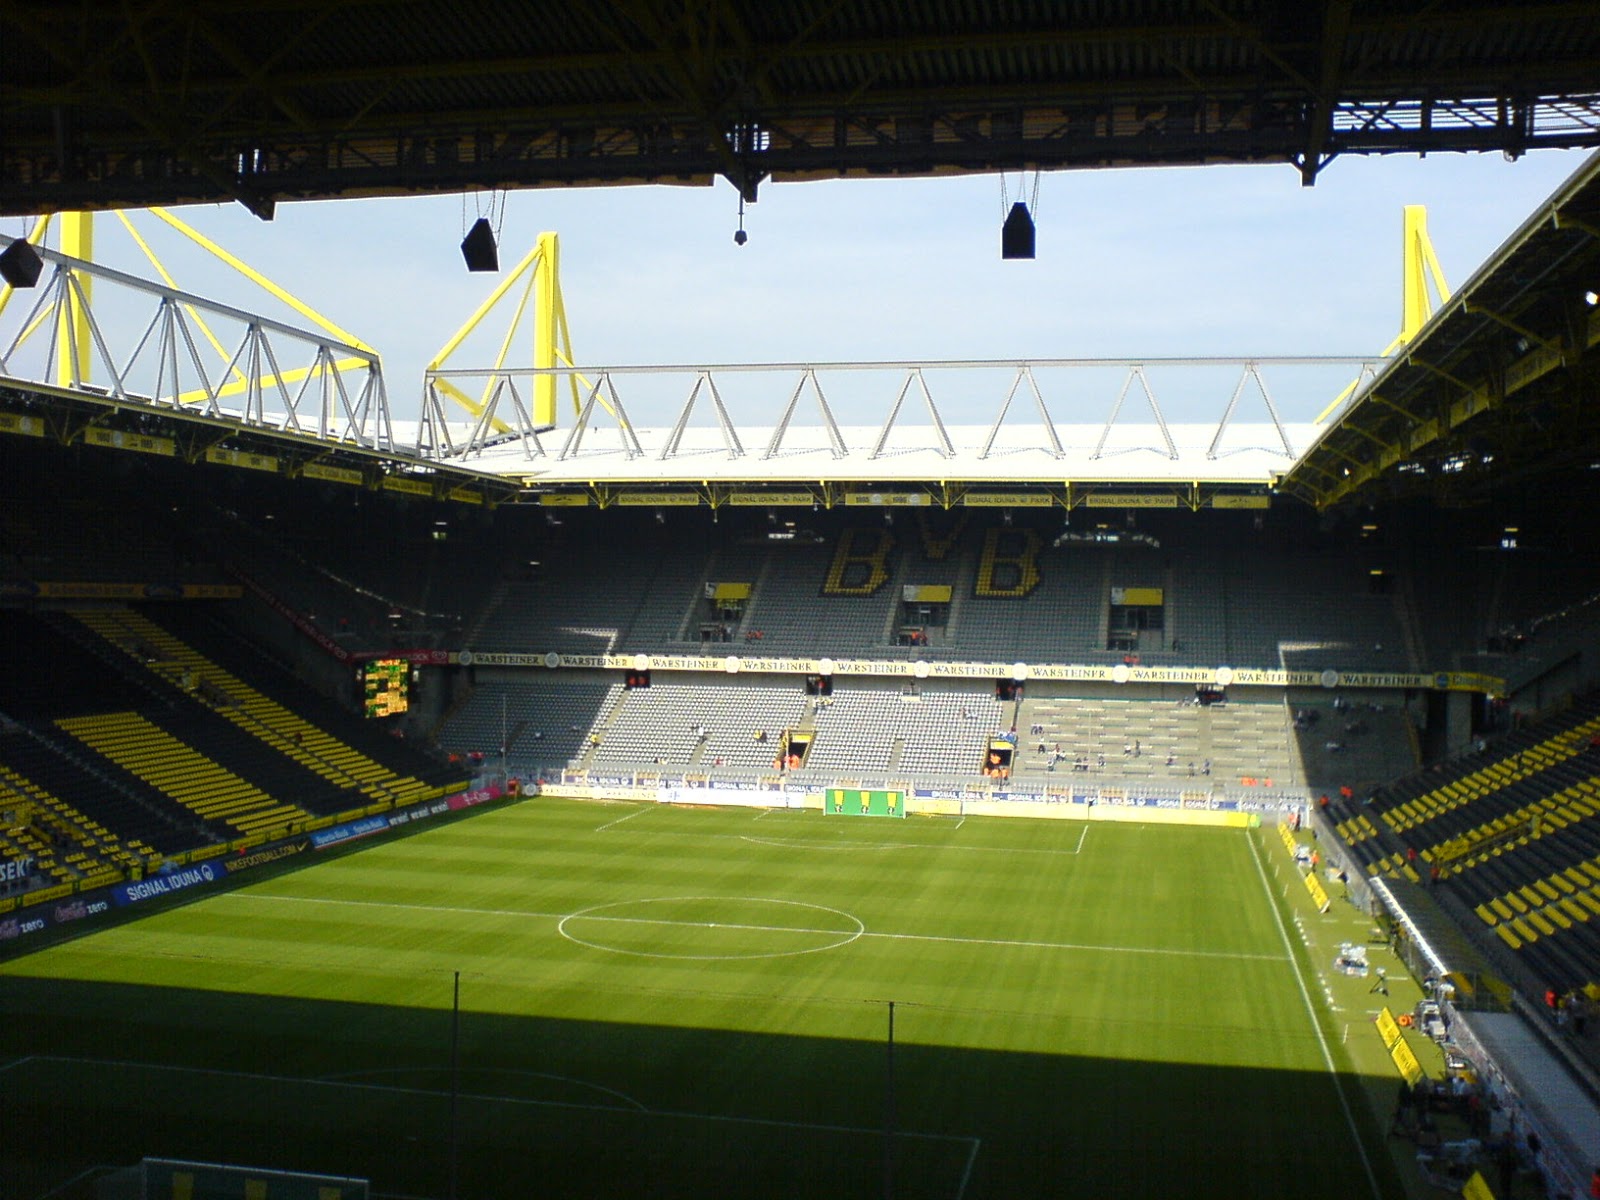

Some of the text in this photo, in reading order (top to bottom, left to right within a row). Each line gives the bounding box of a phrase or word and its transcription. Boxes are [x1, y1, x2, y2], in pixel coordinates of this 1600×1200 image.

[475, 654, 1421, 685] WARSTEINER WARSTEINER WARSTEINER WARSTEINER WARSTEINER WARSTEINER WARSTEINER WARSTEINER WARSTEINER WARSTEINER
[126, 879, 170, 901] SIGNAL
[167, 869, 203, 890] IDUNA
[86, 901, 108, 914] zero
[20, 919, 45, 933] zero
